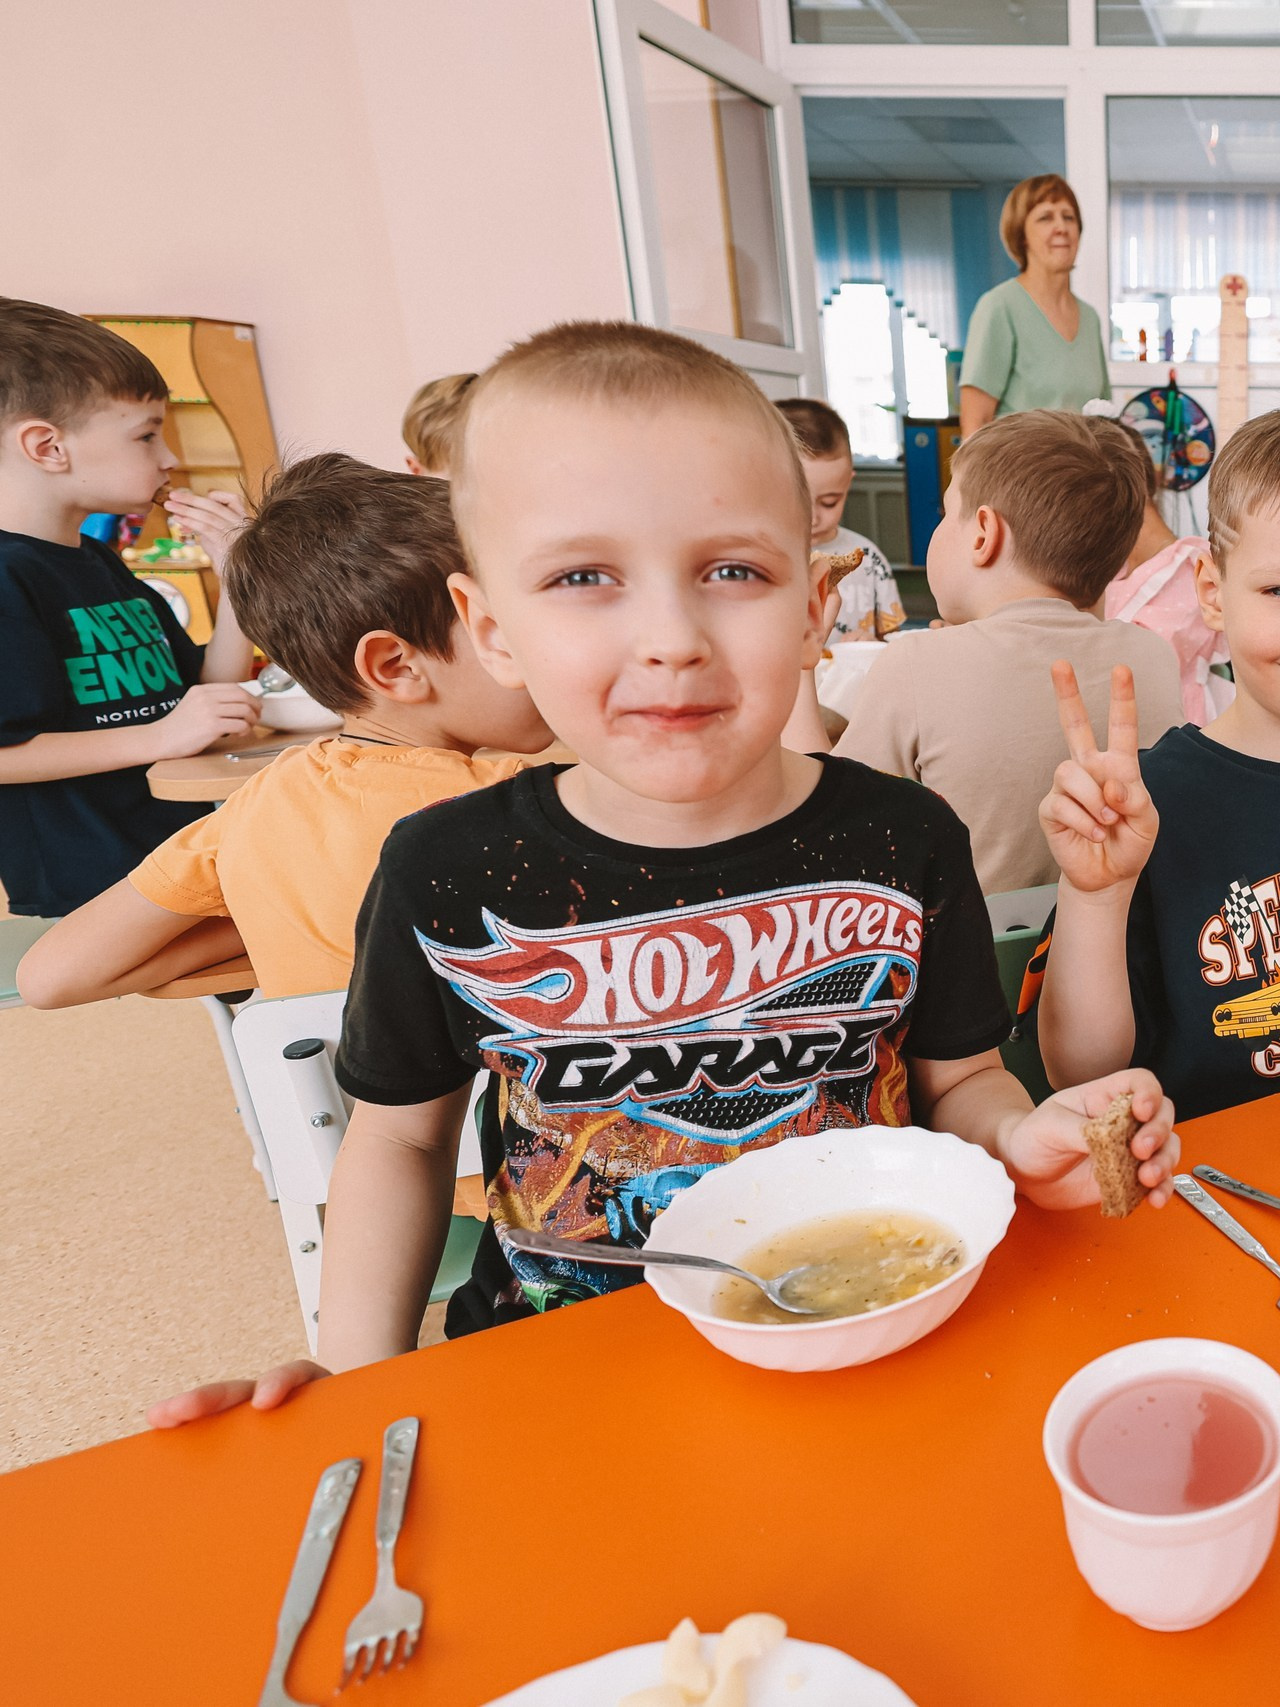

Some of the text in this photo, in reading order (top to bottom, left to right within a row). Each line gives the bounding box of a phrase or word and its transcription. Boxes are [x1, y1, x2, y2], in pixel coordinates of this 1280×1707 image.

[95, 704, 157, 724] NOTICE
[549, 930, 723, 1026] HOT
[536, 1014, 898, 1101] GARAGE
